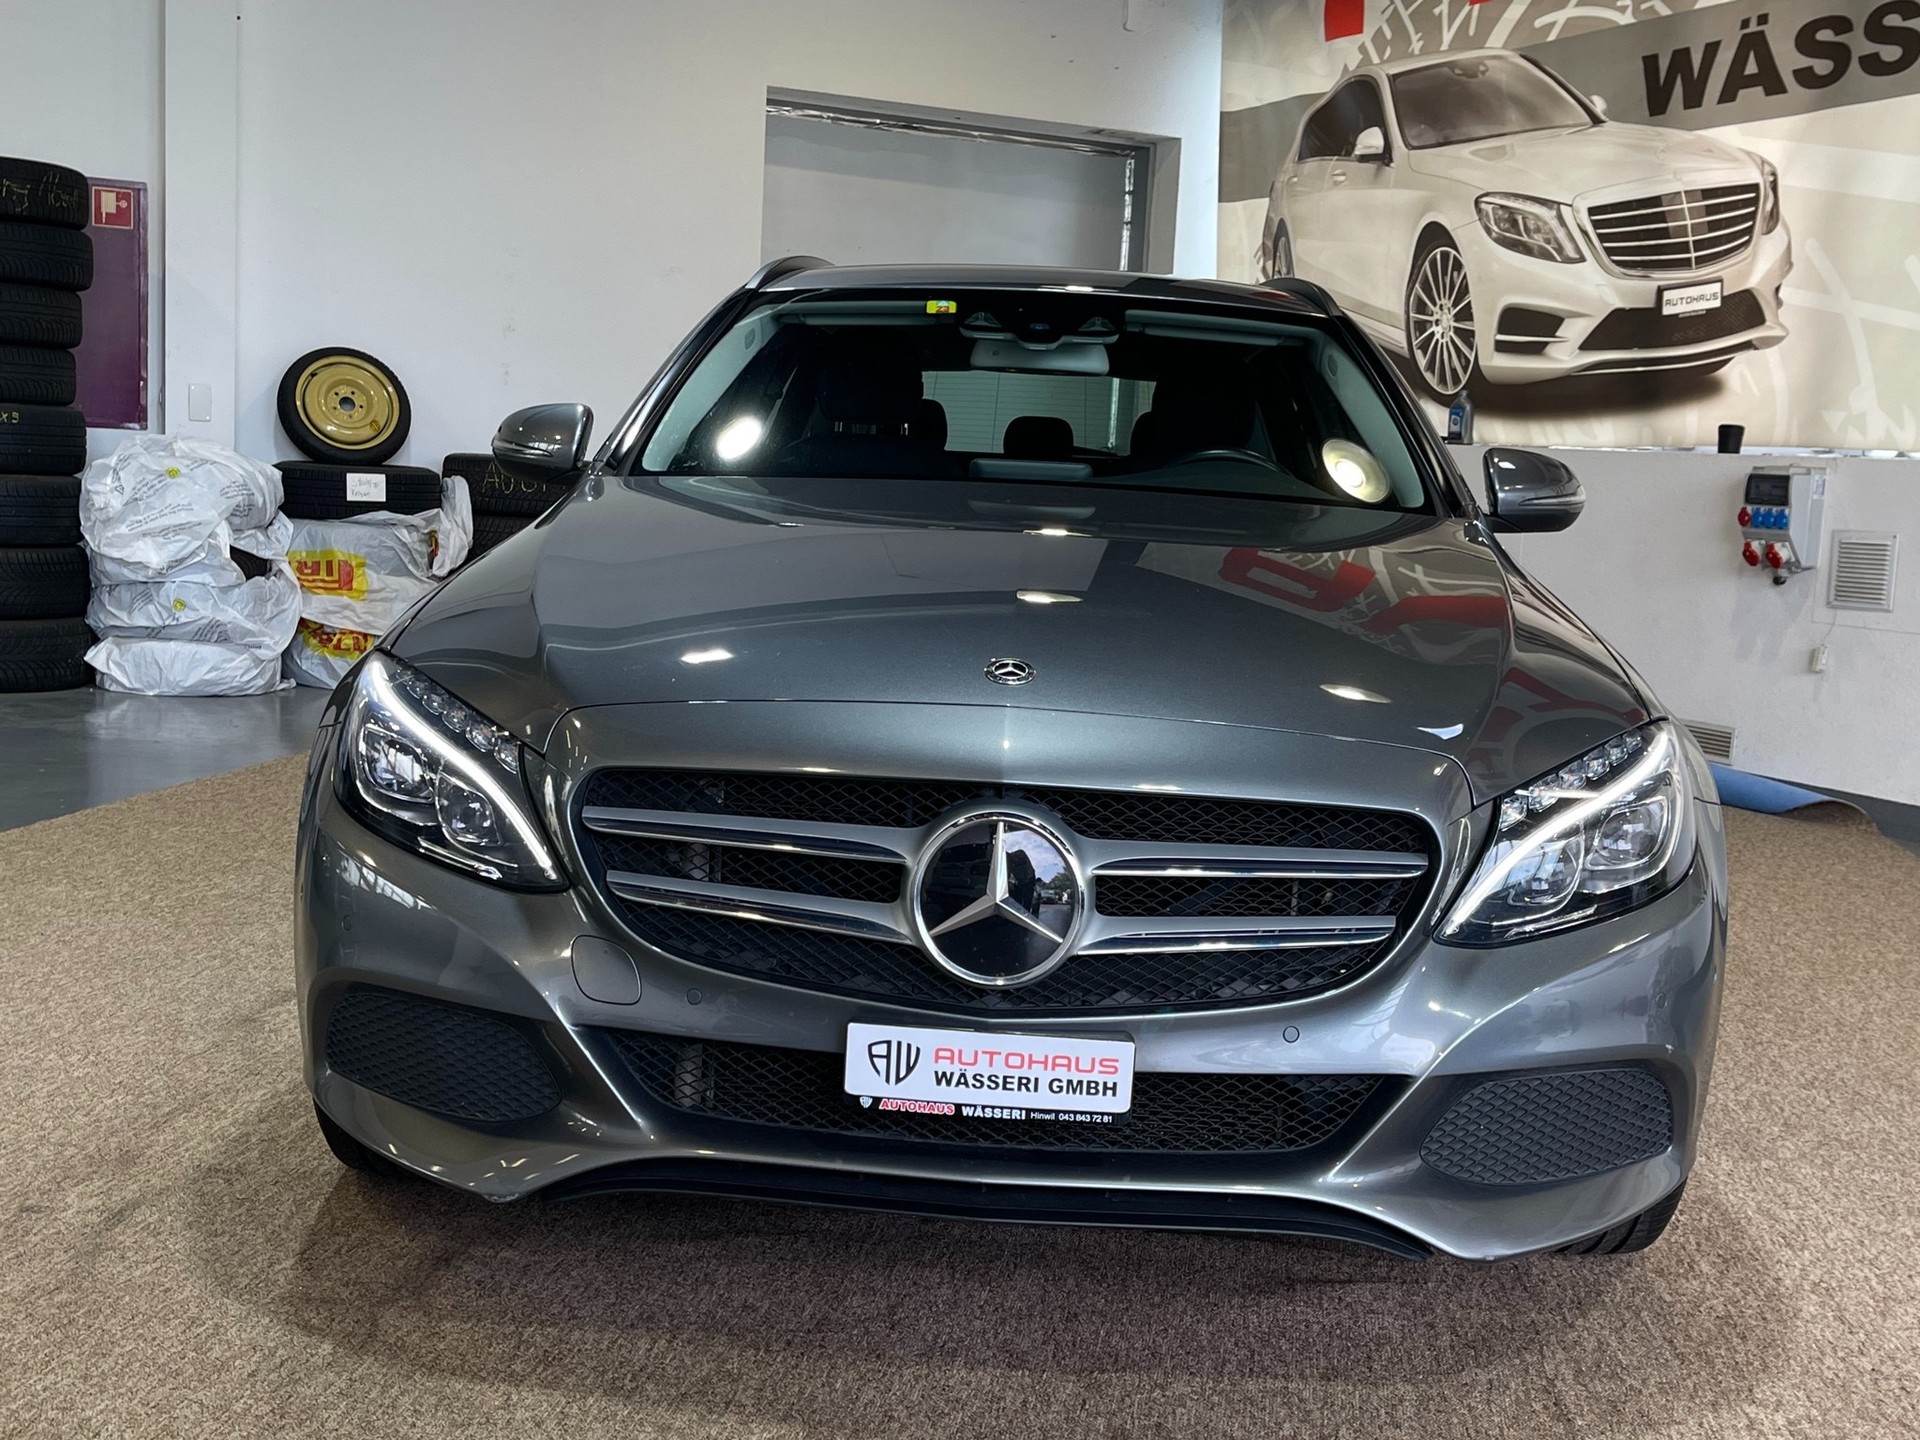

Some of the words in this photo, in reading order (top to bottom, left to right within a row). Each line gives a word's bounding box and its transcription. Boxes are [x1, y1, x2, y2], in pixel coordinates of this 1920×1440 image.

[1641, 0, 1920, 117] WÄSS
[1664, 291, 1719, 307] AUTOHAUS
[933, 1047, 1120, 1075] AUTOHAUS
[933, 1068, 1040, 1093] WÄSSERI
[1048, 1078, 1118, 1097] GMBH
[879, 1098, 955, 1115] AUTOHAUS
[961, 1104, 1026, 1120] WÄSSERI
[1030, 1111, 1056, 1121] Hinwil
[1058, 1112, 1075, 1122] 043
[1075, 1113, 1091, 1123] 843
[1092, 1114, 1102, 1123] 72
[1103, 1115, 1113, 1124] 81
